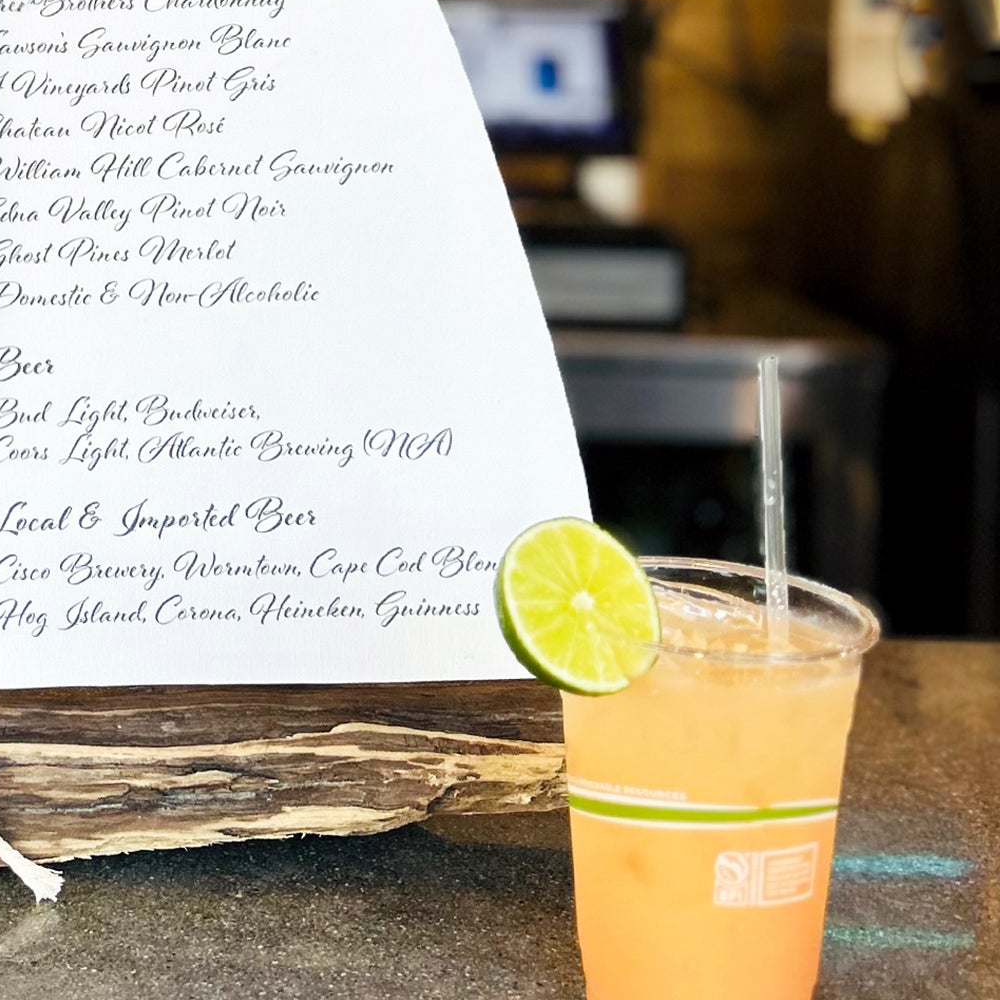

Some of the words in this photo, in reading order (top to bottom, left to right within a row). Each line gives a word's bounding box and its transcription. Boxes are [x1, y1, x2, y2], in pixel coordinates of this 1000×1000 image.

[79, 28, 200, 61] Sauvignon
[211, 25, 290, 54] Blanc
[12, 71, 129, 106] Vineyards
[141, 69, 215, 95] Pinot
[224, 67, 274, 100] Gris
[82, 112, 156, 139] Nicot
[164, 110, 224, 137] Rosé
[91, 153, 151, 182] Hill
[158, 152, 262, 179] Cabernet
[270, 150, 392, 184] Sauvignon
[49, 197, 131, 231] Valley
[141, 194, 215, 222] Pinot
[223, 193, 284, 220] Noir
[59, 238, 128, 266] Pines
[140, 237, 235, 264] Merlot
[101, 282, 118, 303] &
[130, 278, 318, 307] Non-Alcoholic
[61, 397, 127, 432] Light,
[137, 396, 259, 425] Budweiser,
[63, 432, 128, 470] Light,
[139, 433, 241, 462] Atlantic
[251, 431, 352, 467] Brewing
[364, 429, 451, 459] (NA)
[80, 502, 101, 528] &
[114, 499, 239, 539] Imported
[246, 497, 315, 532] Beer
[61, 554, 163, 590] Brewery,
[174, 551, 300, 579] Wormtown,
[311, 549, 366, 582] Cape
[377, 548, 426, 576] Cod
[433, 547, 495, 577] Blon
[60, 597, 146, 629] Island,
[156, 595, 240, 624] Corona,
[251, 593, 363, 624] Heineken,
[376, 591, 478, 626] Guinness
